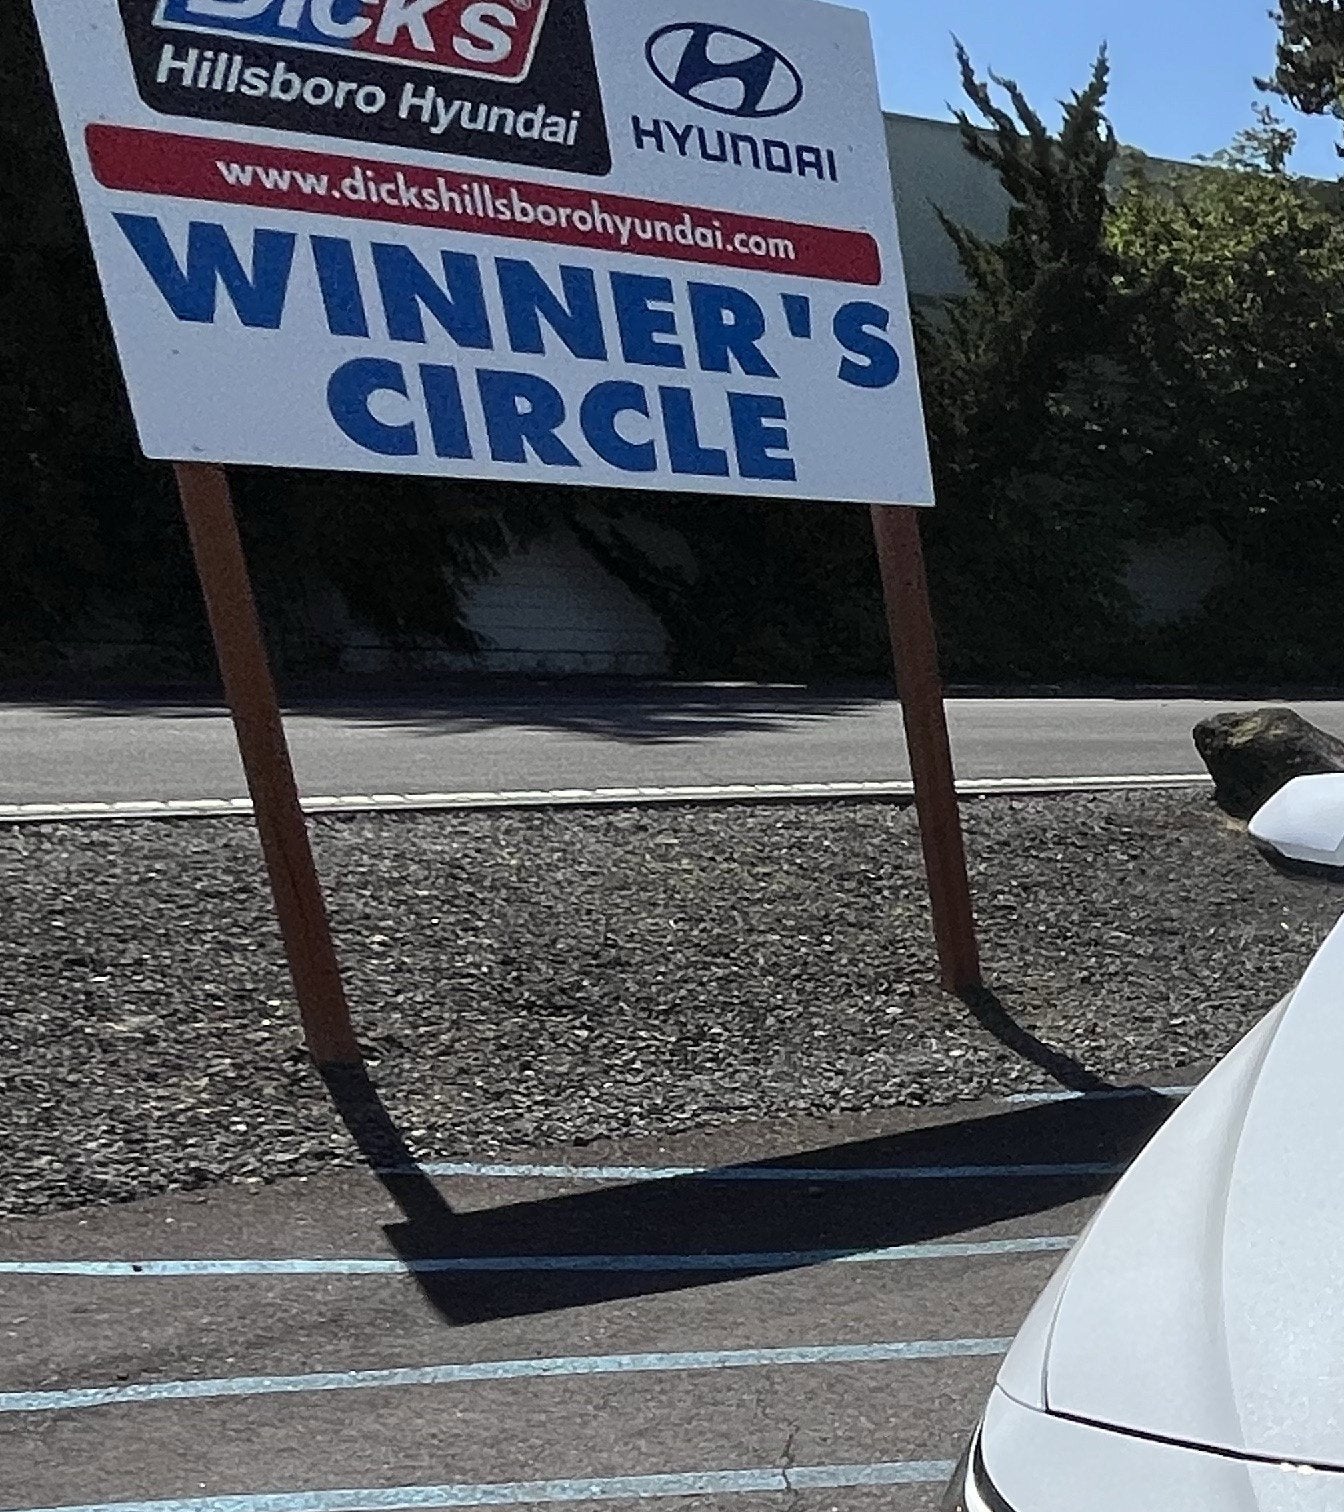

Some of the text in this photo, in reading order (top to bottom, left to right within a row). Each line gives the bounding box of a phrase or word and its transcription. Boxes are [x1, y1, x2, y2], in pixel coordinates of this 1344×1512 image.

[186, 0, 517, 63] cks
[157, 44, 582, 146] Hillsboro Hyundai
[632, 115, 838, 183] HYUNDAI
[216, 158, 796, 262] www.dickshillsborohyundai.com
[111, 211, 901, 389] WINNER'S
[326, 356, 798, 482] CIRCLE
